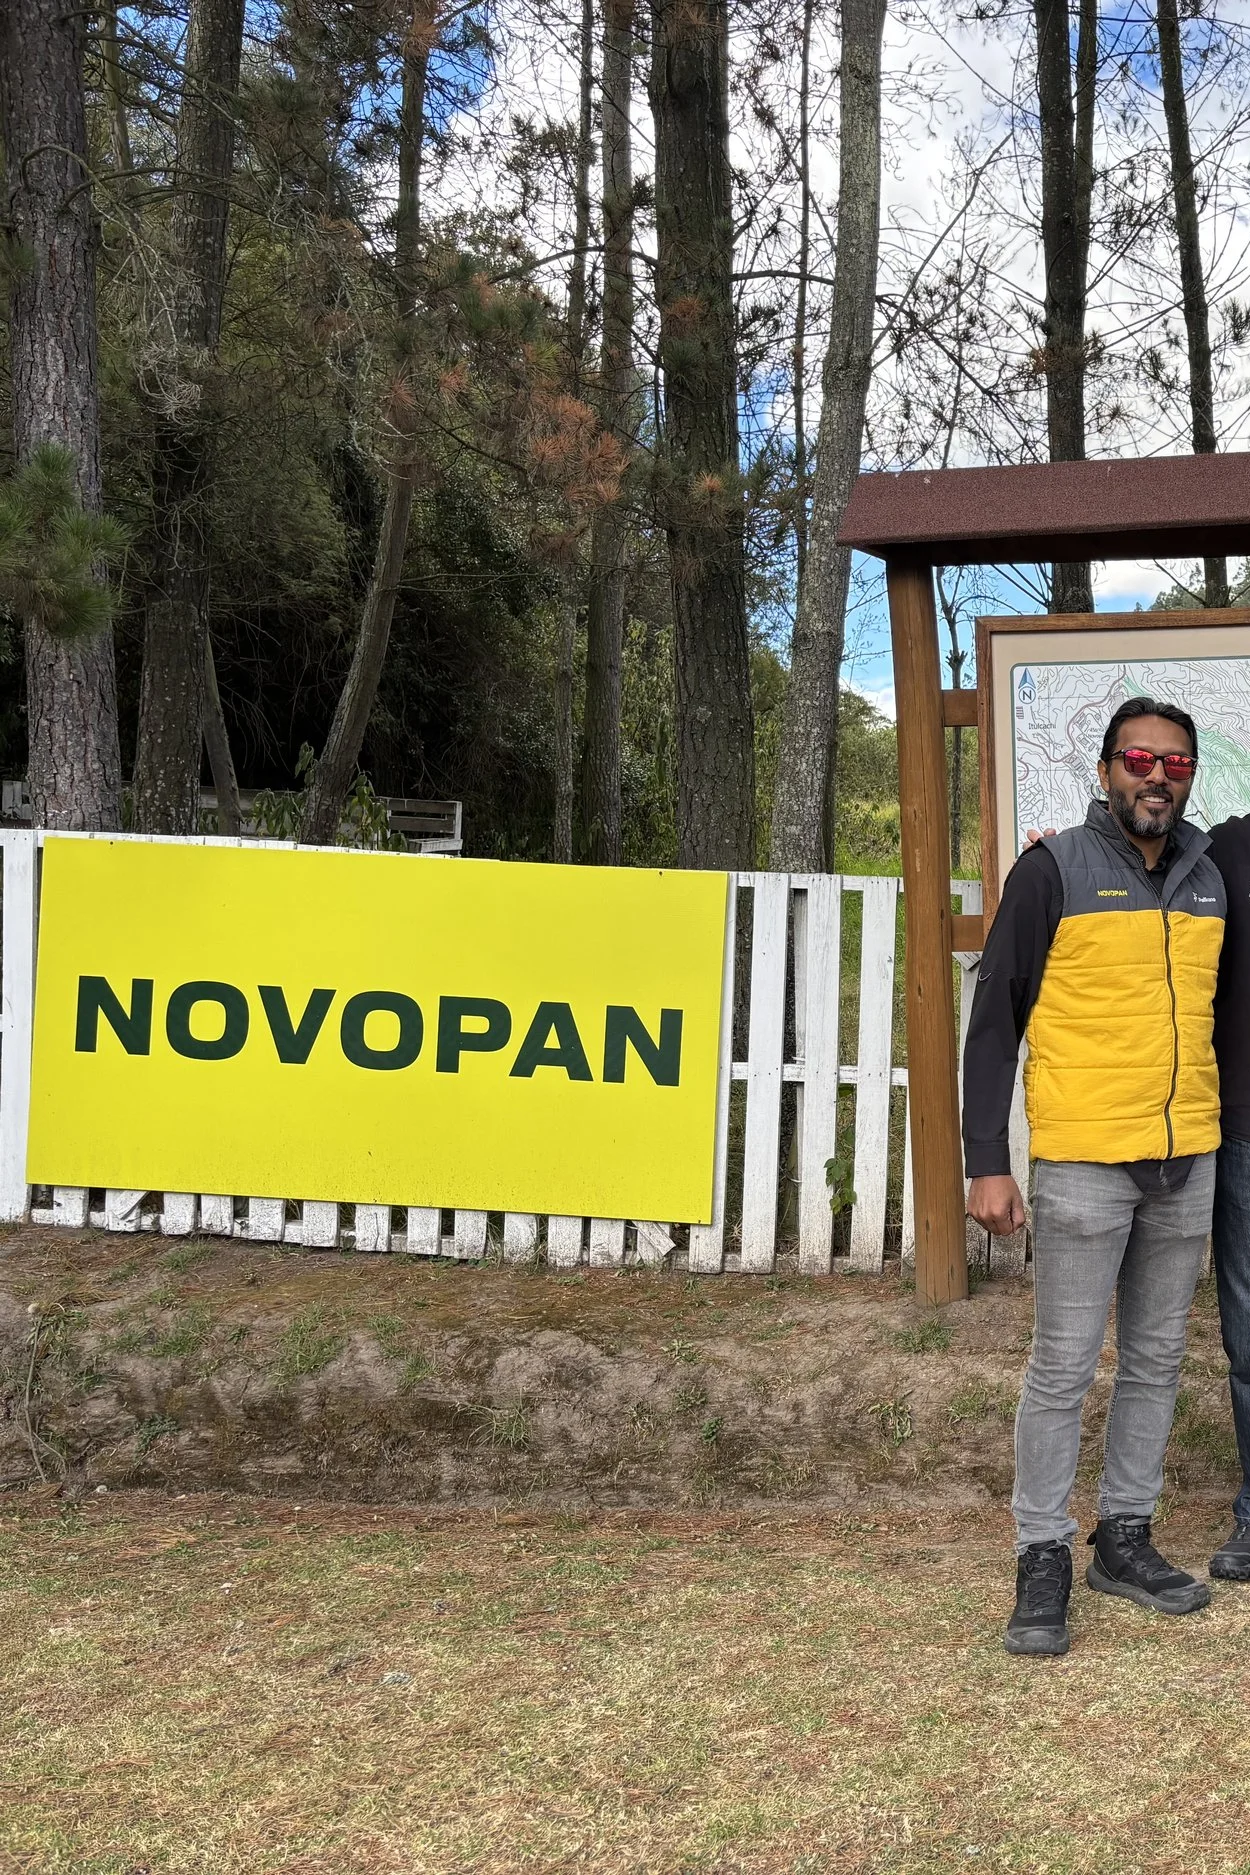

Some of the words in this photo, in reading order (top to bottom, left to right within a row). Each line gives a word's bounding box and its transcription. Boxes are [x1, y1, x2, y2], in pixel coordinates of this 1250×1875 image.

[1028, 722, 1056, 730] Itulcachi
[1097, 889, 1128, 897] NOVOPAN
[73, 975, 684, 1088] NOVOPAN
